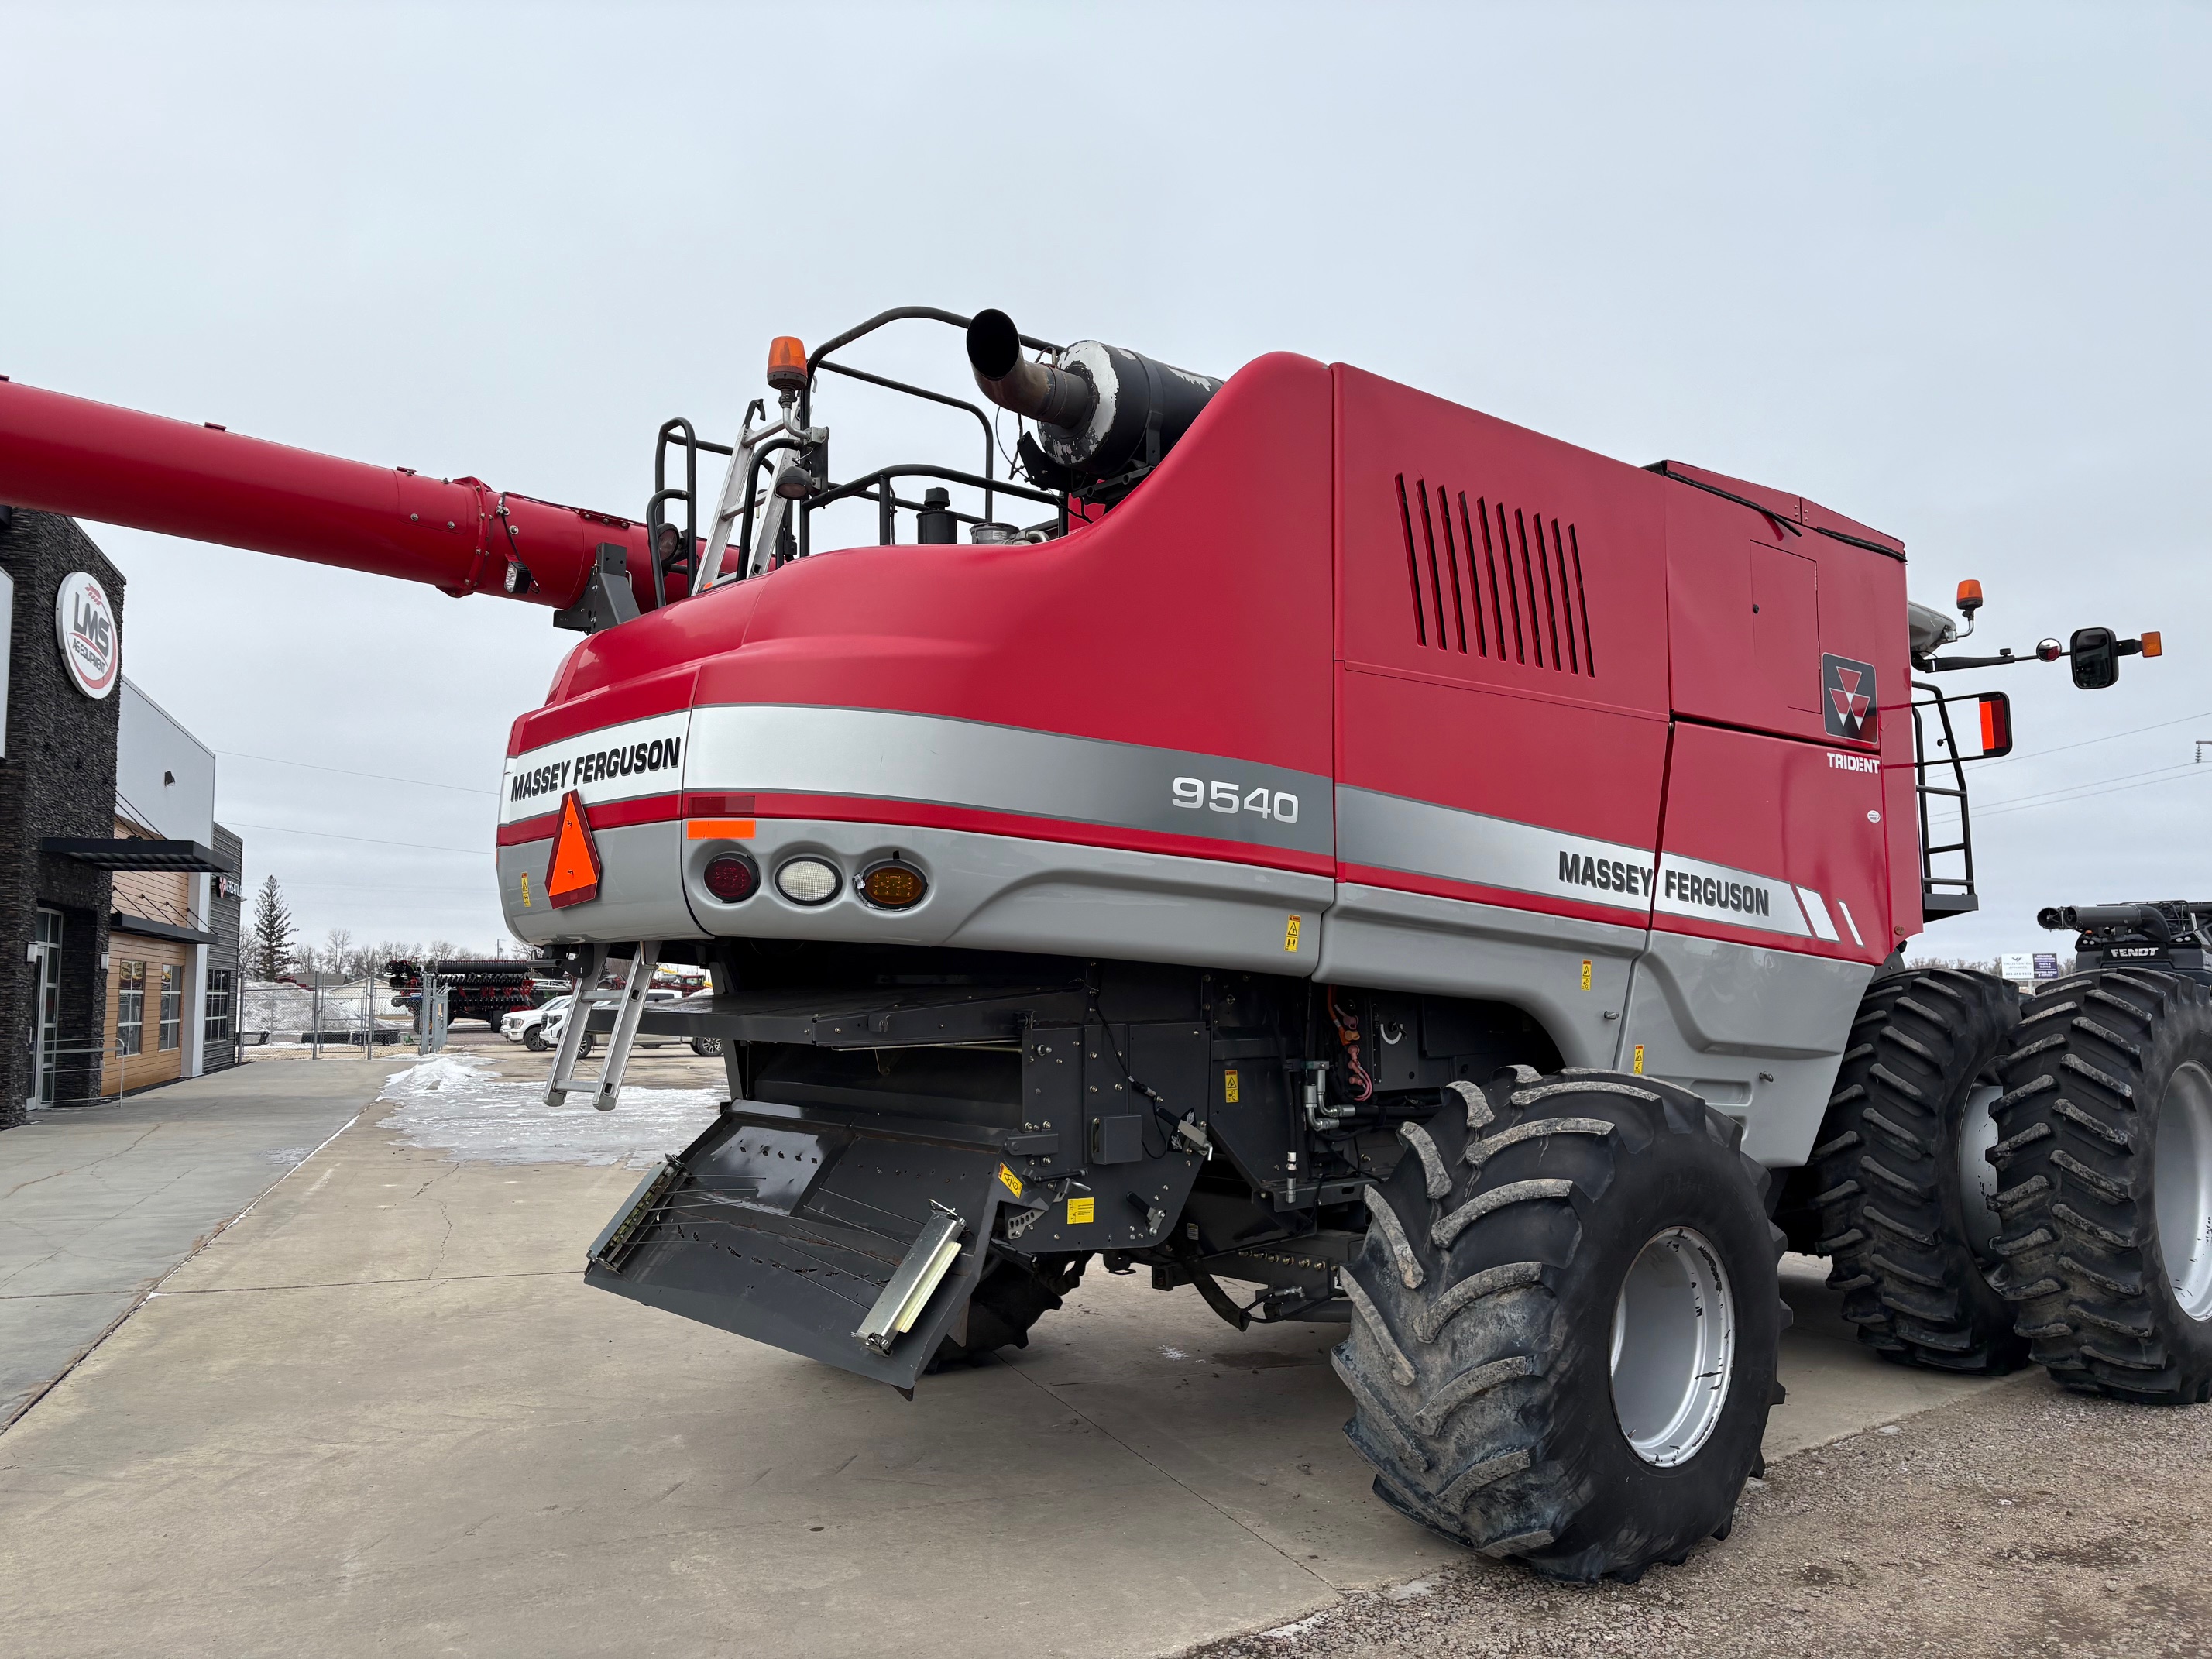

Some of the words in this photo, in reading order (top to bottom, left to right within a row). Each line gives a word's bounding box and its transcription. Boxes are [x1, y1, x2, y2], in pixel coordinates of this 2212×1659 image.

[74, 592, 110, 658] LMS
[72, 637, 81, 653] AG
[79, 644, 106, 675] EQUIPMENT
[511, 760, 571, 802] MASSEY
[573, 737, 681, 786] FERGUSON
[1826, 752, 1880, 774] TRIDENT
[1172, 777, 1299, 823] 9540
[1559, 850, 1654, 898] MASSEY
[1665, 869, 1770, 916] FERGUSON
[2110, 947, 2159, 957] FENDT
